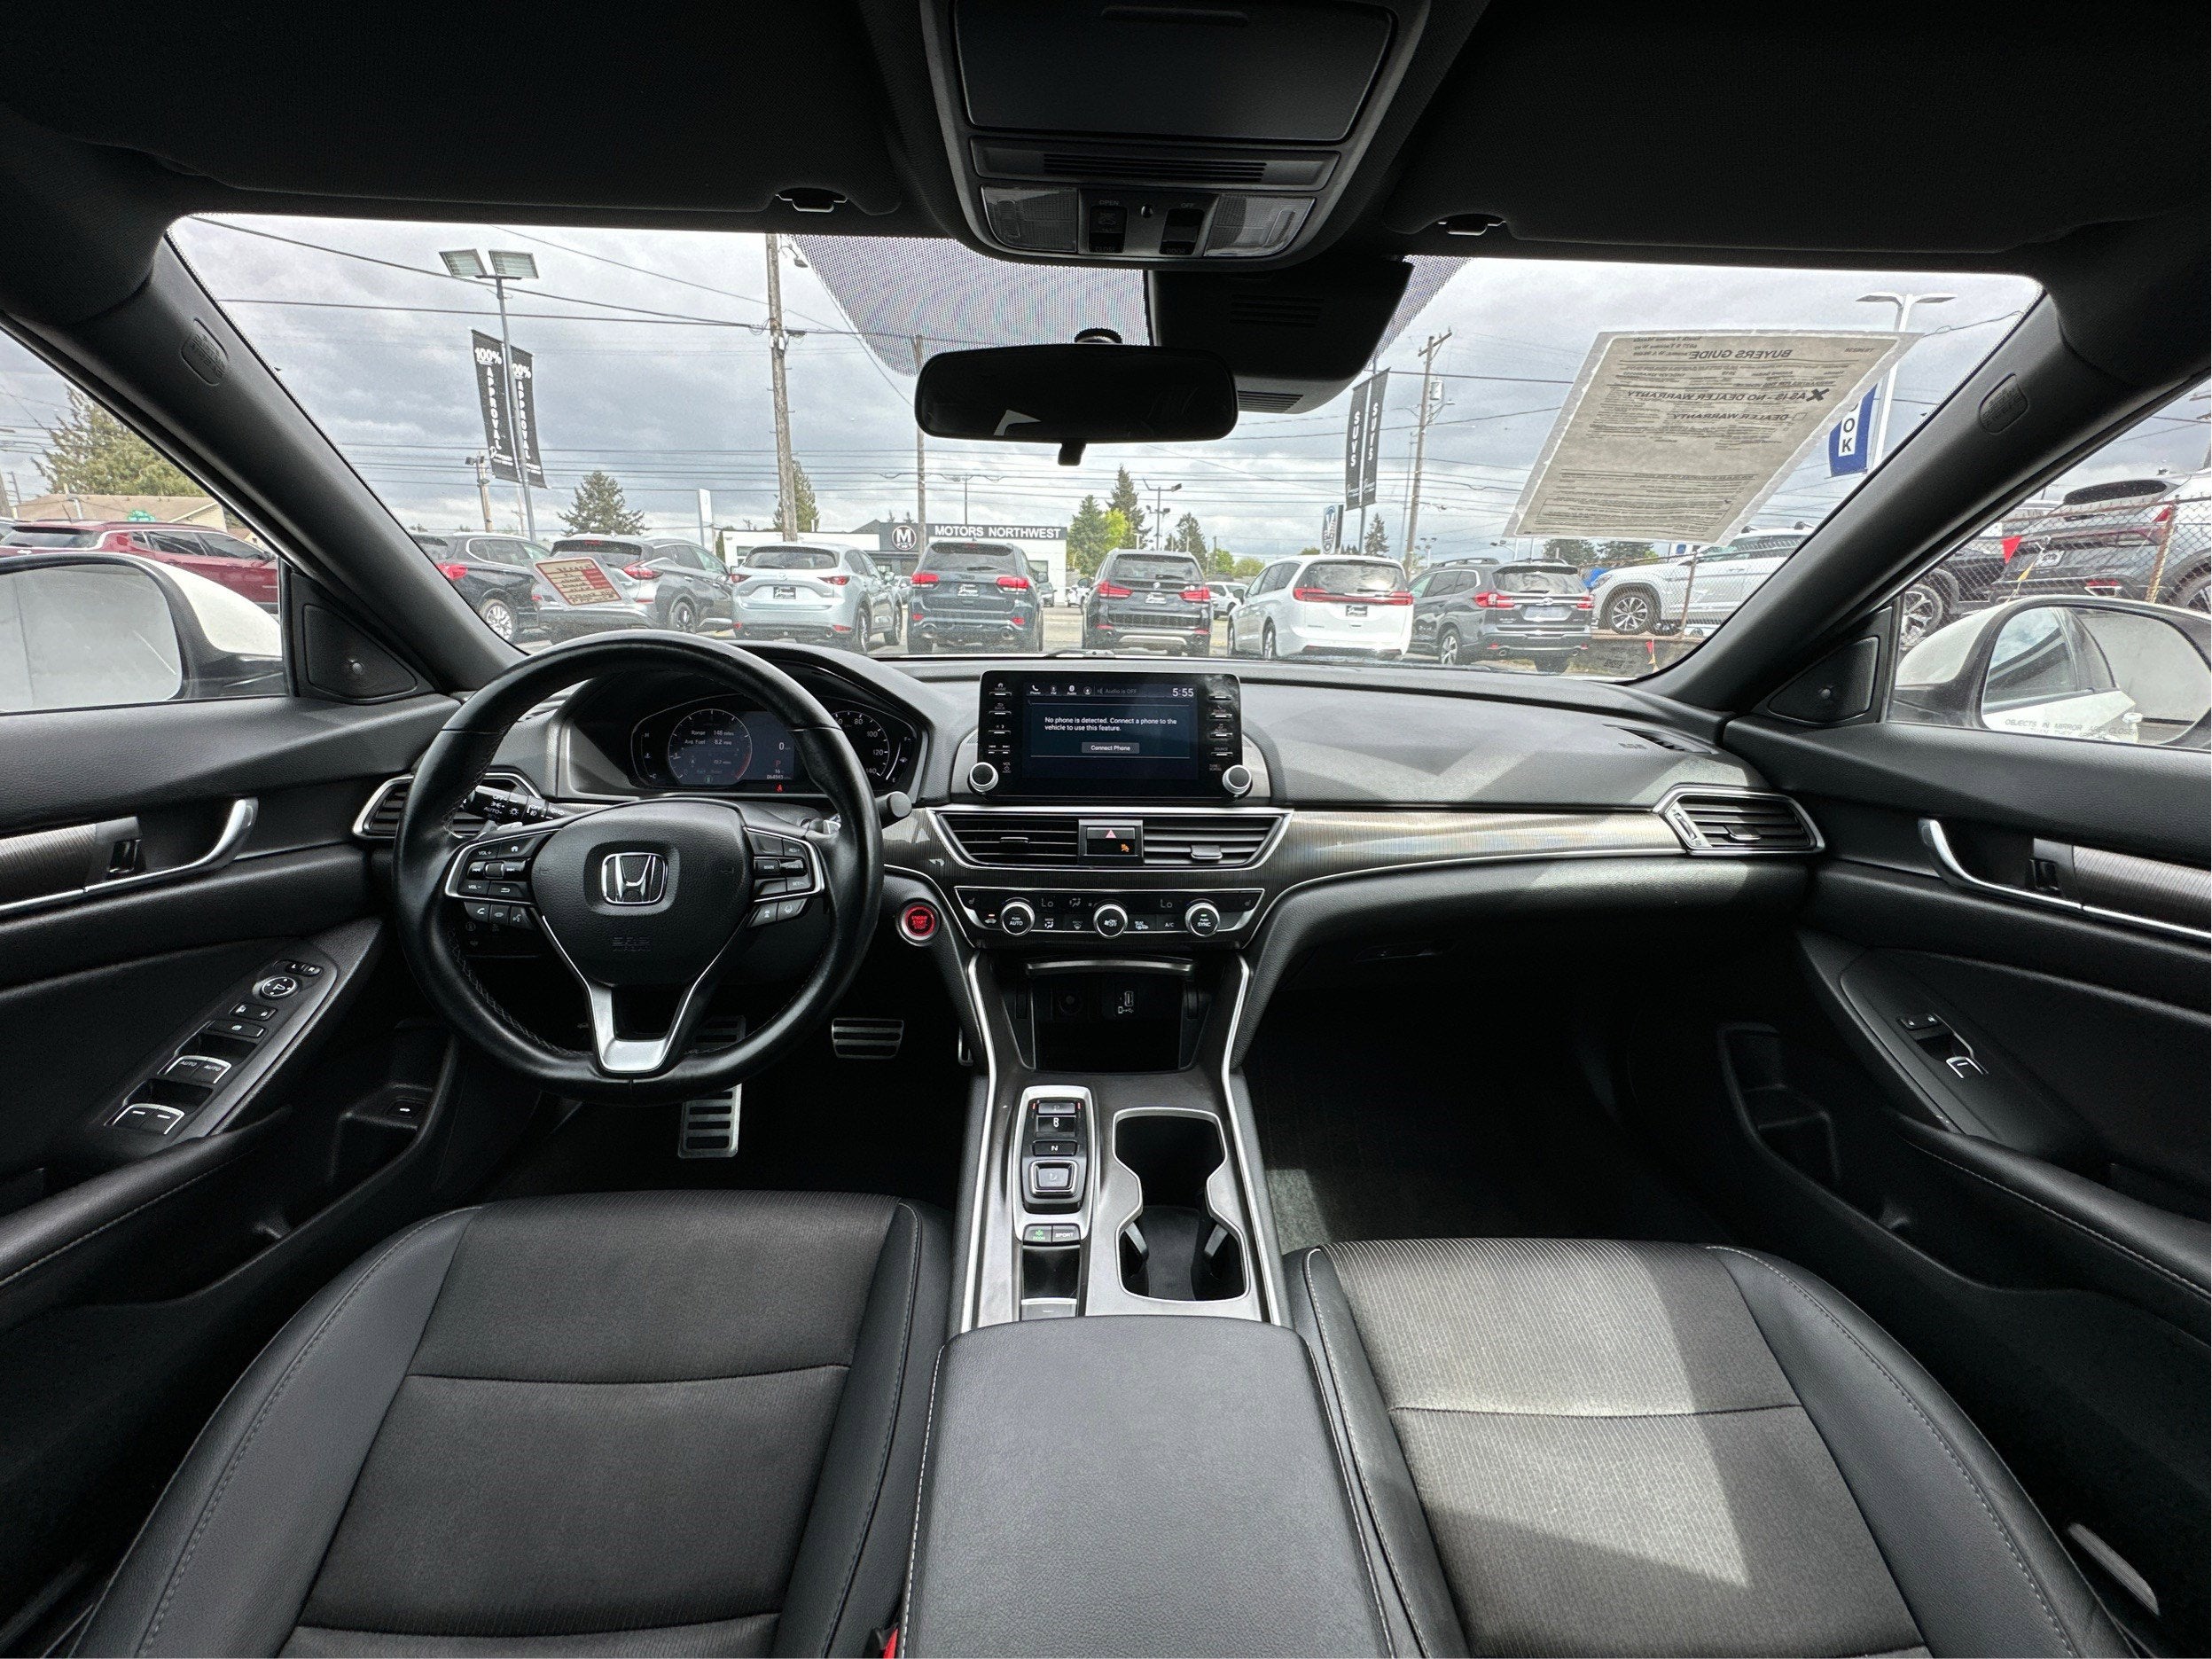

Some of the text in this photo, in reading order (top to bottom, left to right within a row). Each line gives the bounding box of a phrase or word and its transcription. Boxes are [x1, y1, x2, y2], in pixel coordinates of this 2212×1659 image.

[474, 348, 502, 364] 100%
[486, 366, 502, 450] APPROVAL
[517, 380, 531, 460] APPROVAL
[896, 529, 911, 543] M
[934, 526, 1061, 538] MOTORS NORTHWEST
[1172, 687, 1193, 698] 5:55
[2108, 726, 2137, 735] CLOSER
